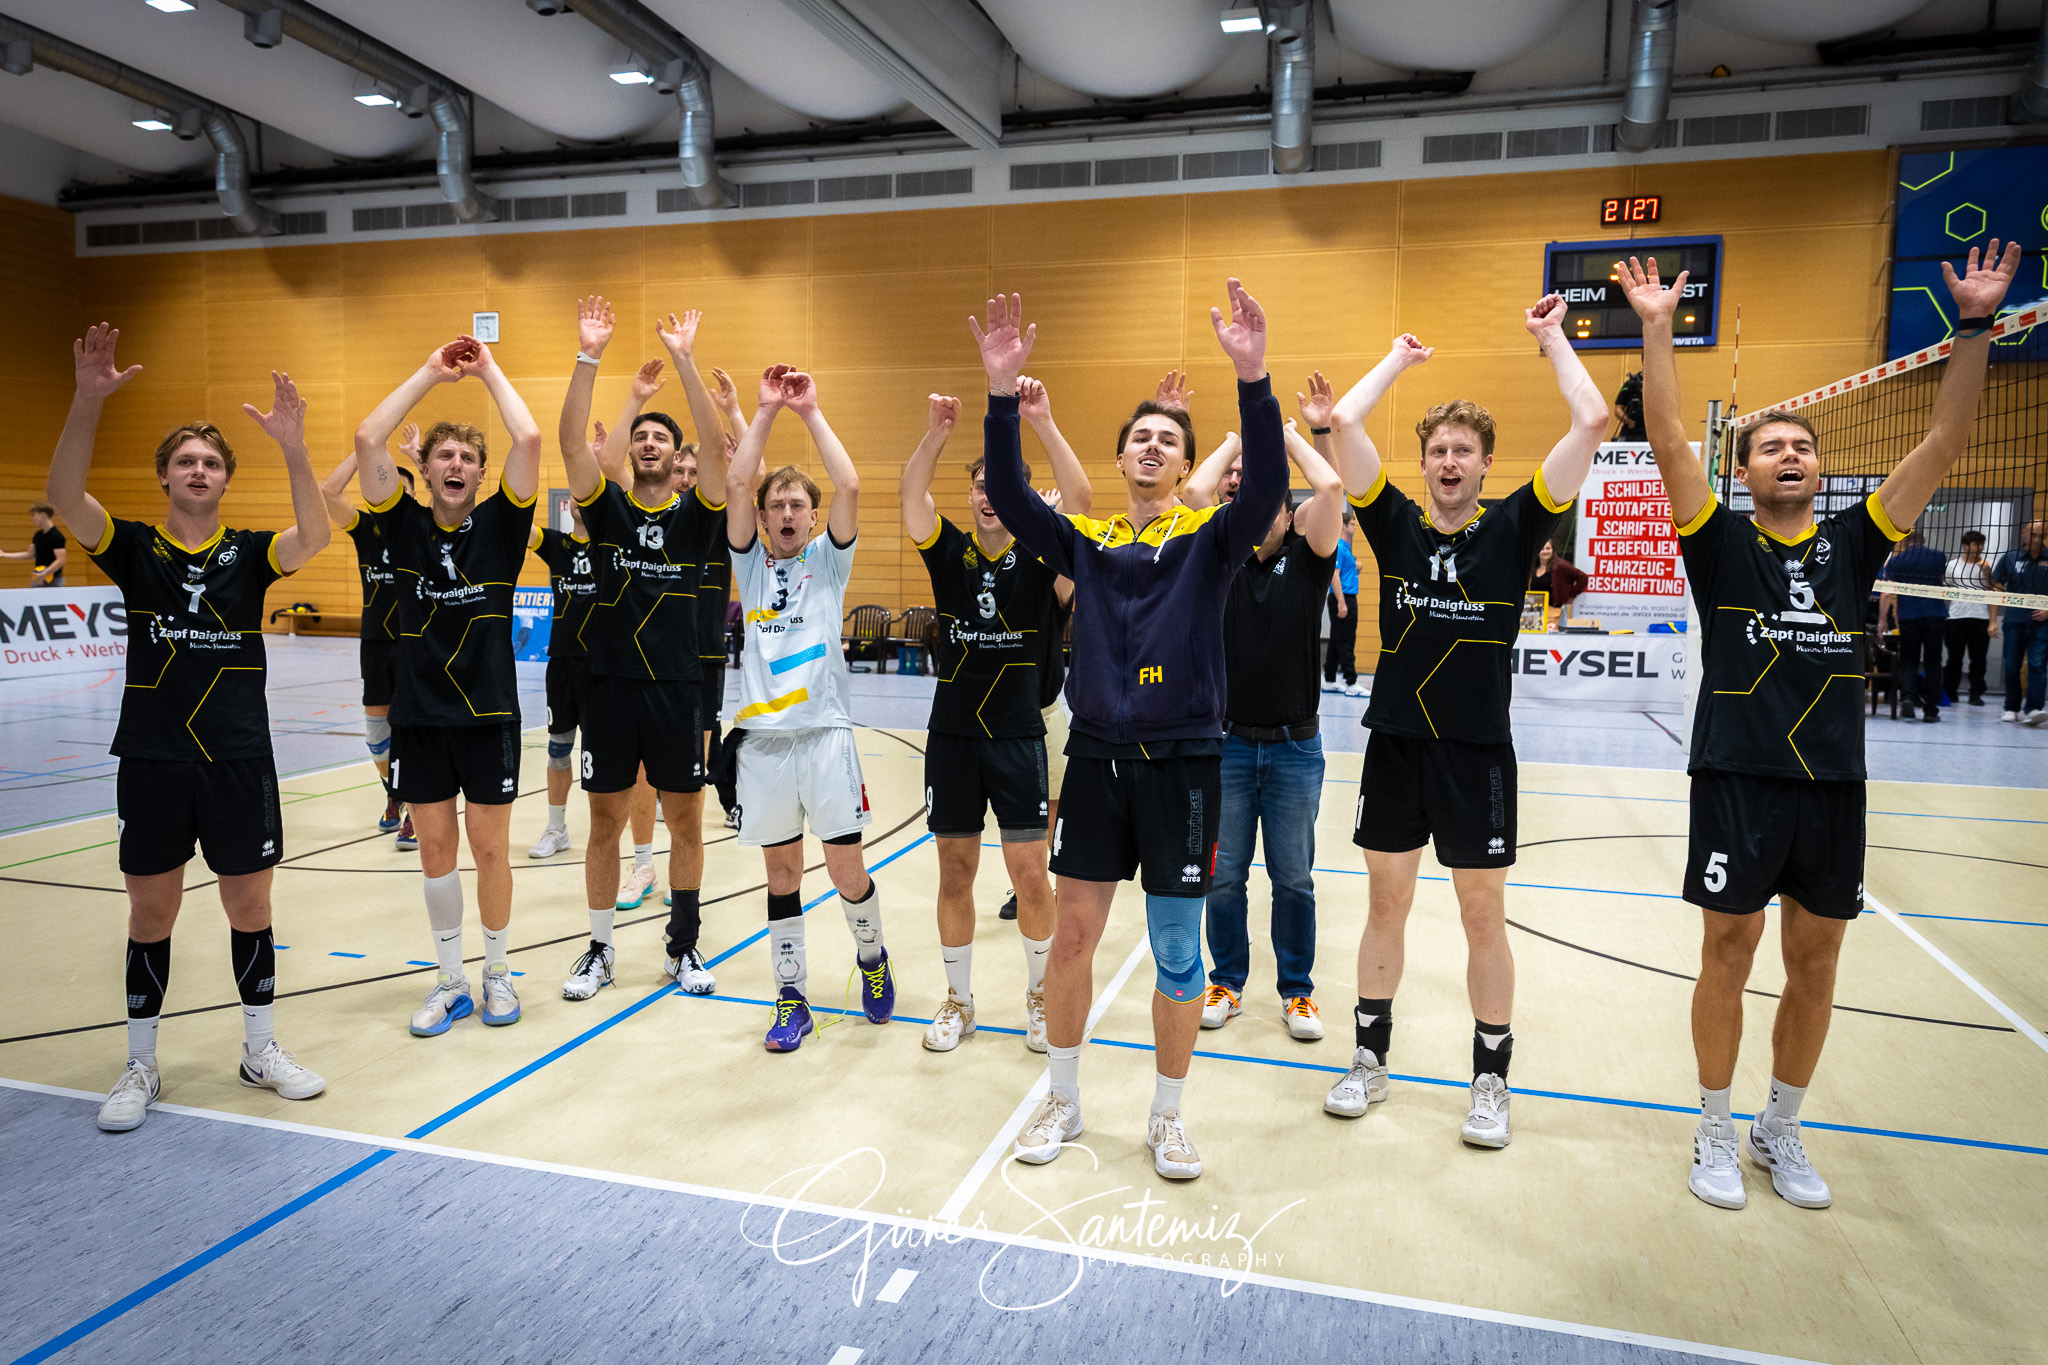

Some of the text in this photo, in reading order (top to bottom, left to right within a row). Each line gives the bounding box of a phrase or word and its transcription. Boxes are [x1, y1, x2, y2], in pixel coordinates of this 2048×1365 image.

[1554, 287, 1606, 303] HEIM
[637, 524, 664, 550] 13
[1602, 520, 1671, 537] SCHRIFTEN
[1594, 540, 1678, 556] KLEBEFOLIEN
[441, 554, 458, 580] 1
[573, 557, 592, 575] 10
[619, 558, 682, 573] Zapf Daigfuss
[1599, 559, 1673, 577] FAHRZEUG-
[563, 583, 577, 591] Zapf
[1587, 577, 1683, 594] BESCHRIFTUNG
[1789, 579, 1815, 611] 5
[182, 583, 207, 613] 7
[771, 588, 789, 611] 3
[976, 591, 997, 619] 9
[1403, 594, 1485, 612] Zapf Daigfuss
[159, 627, 242, 642] Zapf Daigfuss
[956, 630, 1023, 643] Zapf Daigfuss
[1760, 626, 1852, 645] Zapf Daigfuss
[4, 645, 62, 664] Druck
[66, 647, 75, 657] +
[1139, 665, 1163, 685] FH
[391, 759, 400, 790] 1
[925, 786, 934, 817] 9
[1052, 818, 1064, 856] 4
[1703, 852, 1729, 893] 5
